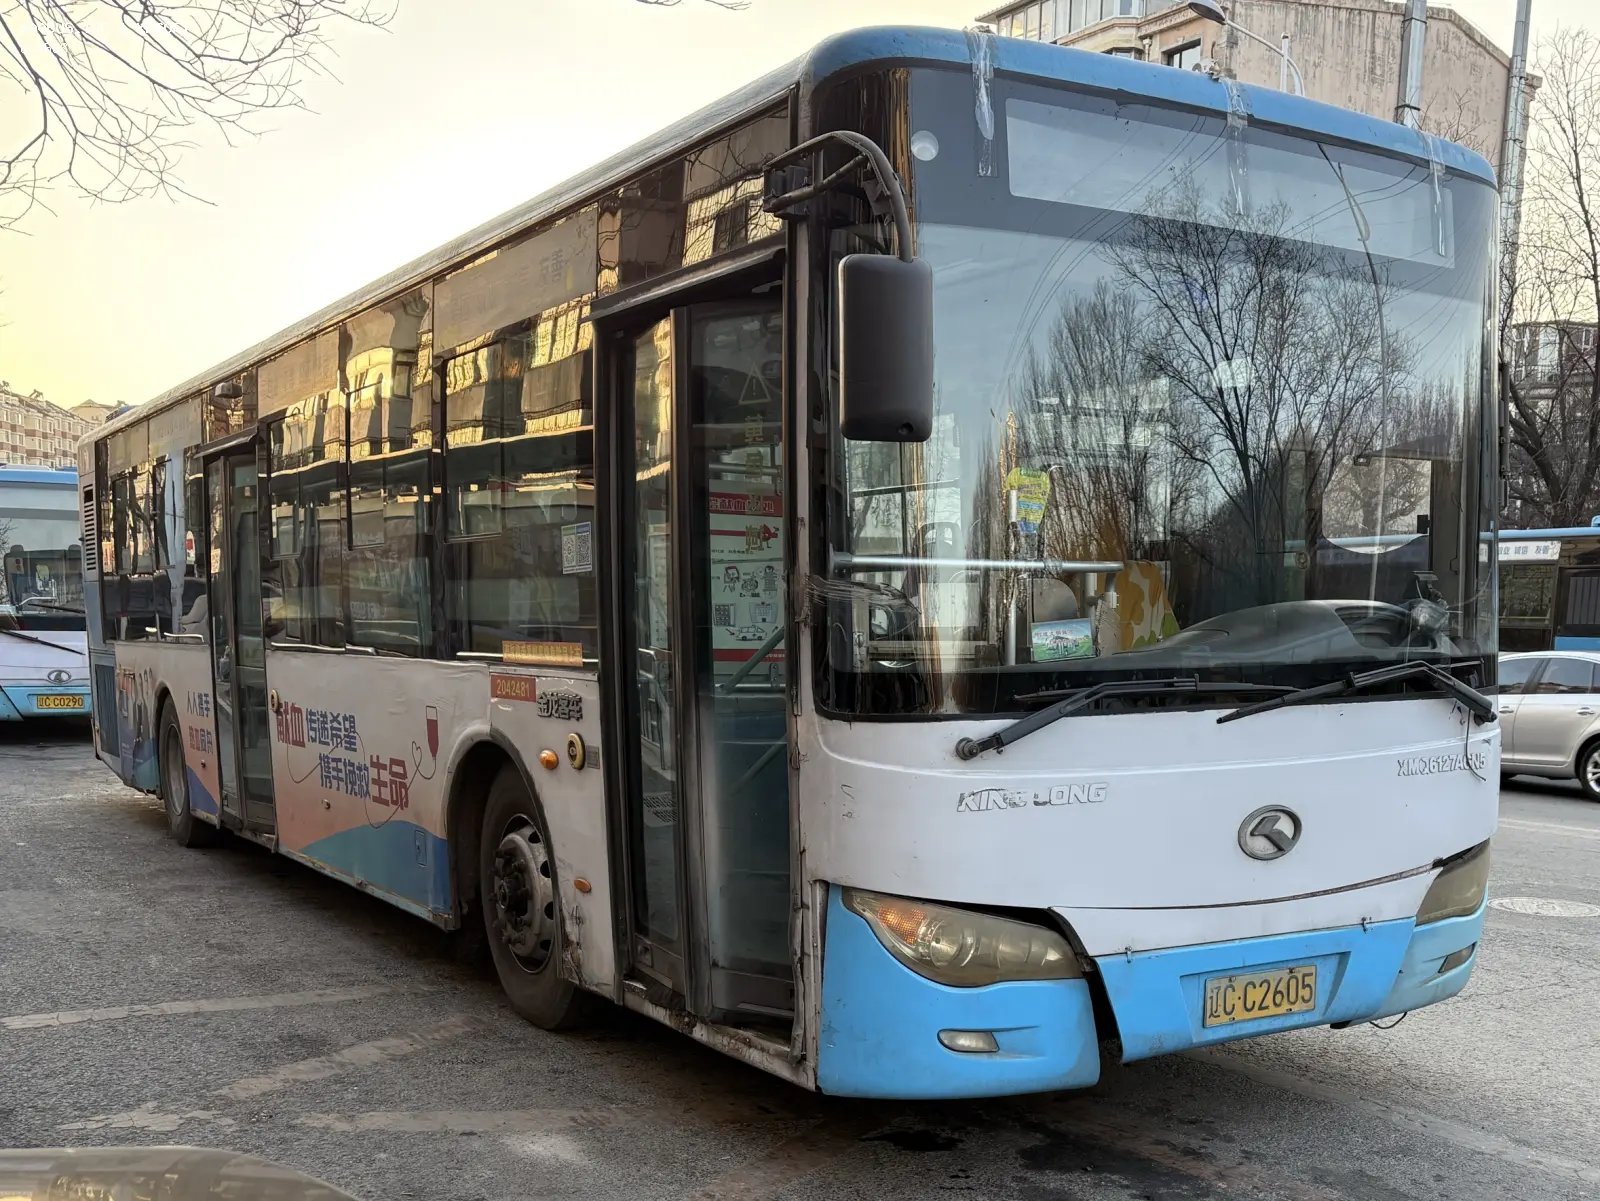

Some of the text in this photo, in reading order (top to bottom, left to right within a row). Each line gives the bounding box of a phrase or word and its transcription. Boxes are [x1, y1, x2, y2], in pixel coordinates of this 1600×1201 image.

[496, 679, 530, 697] 2042481
[537, 692, 583, 721] 金龙客车
